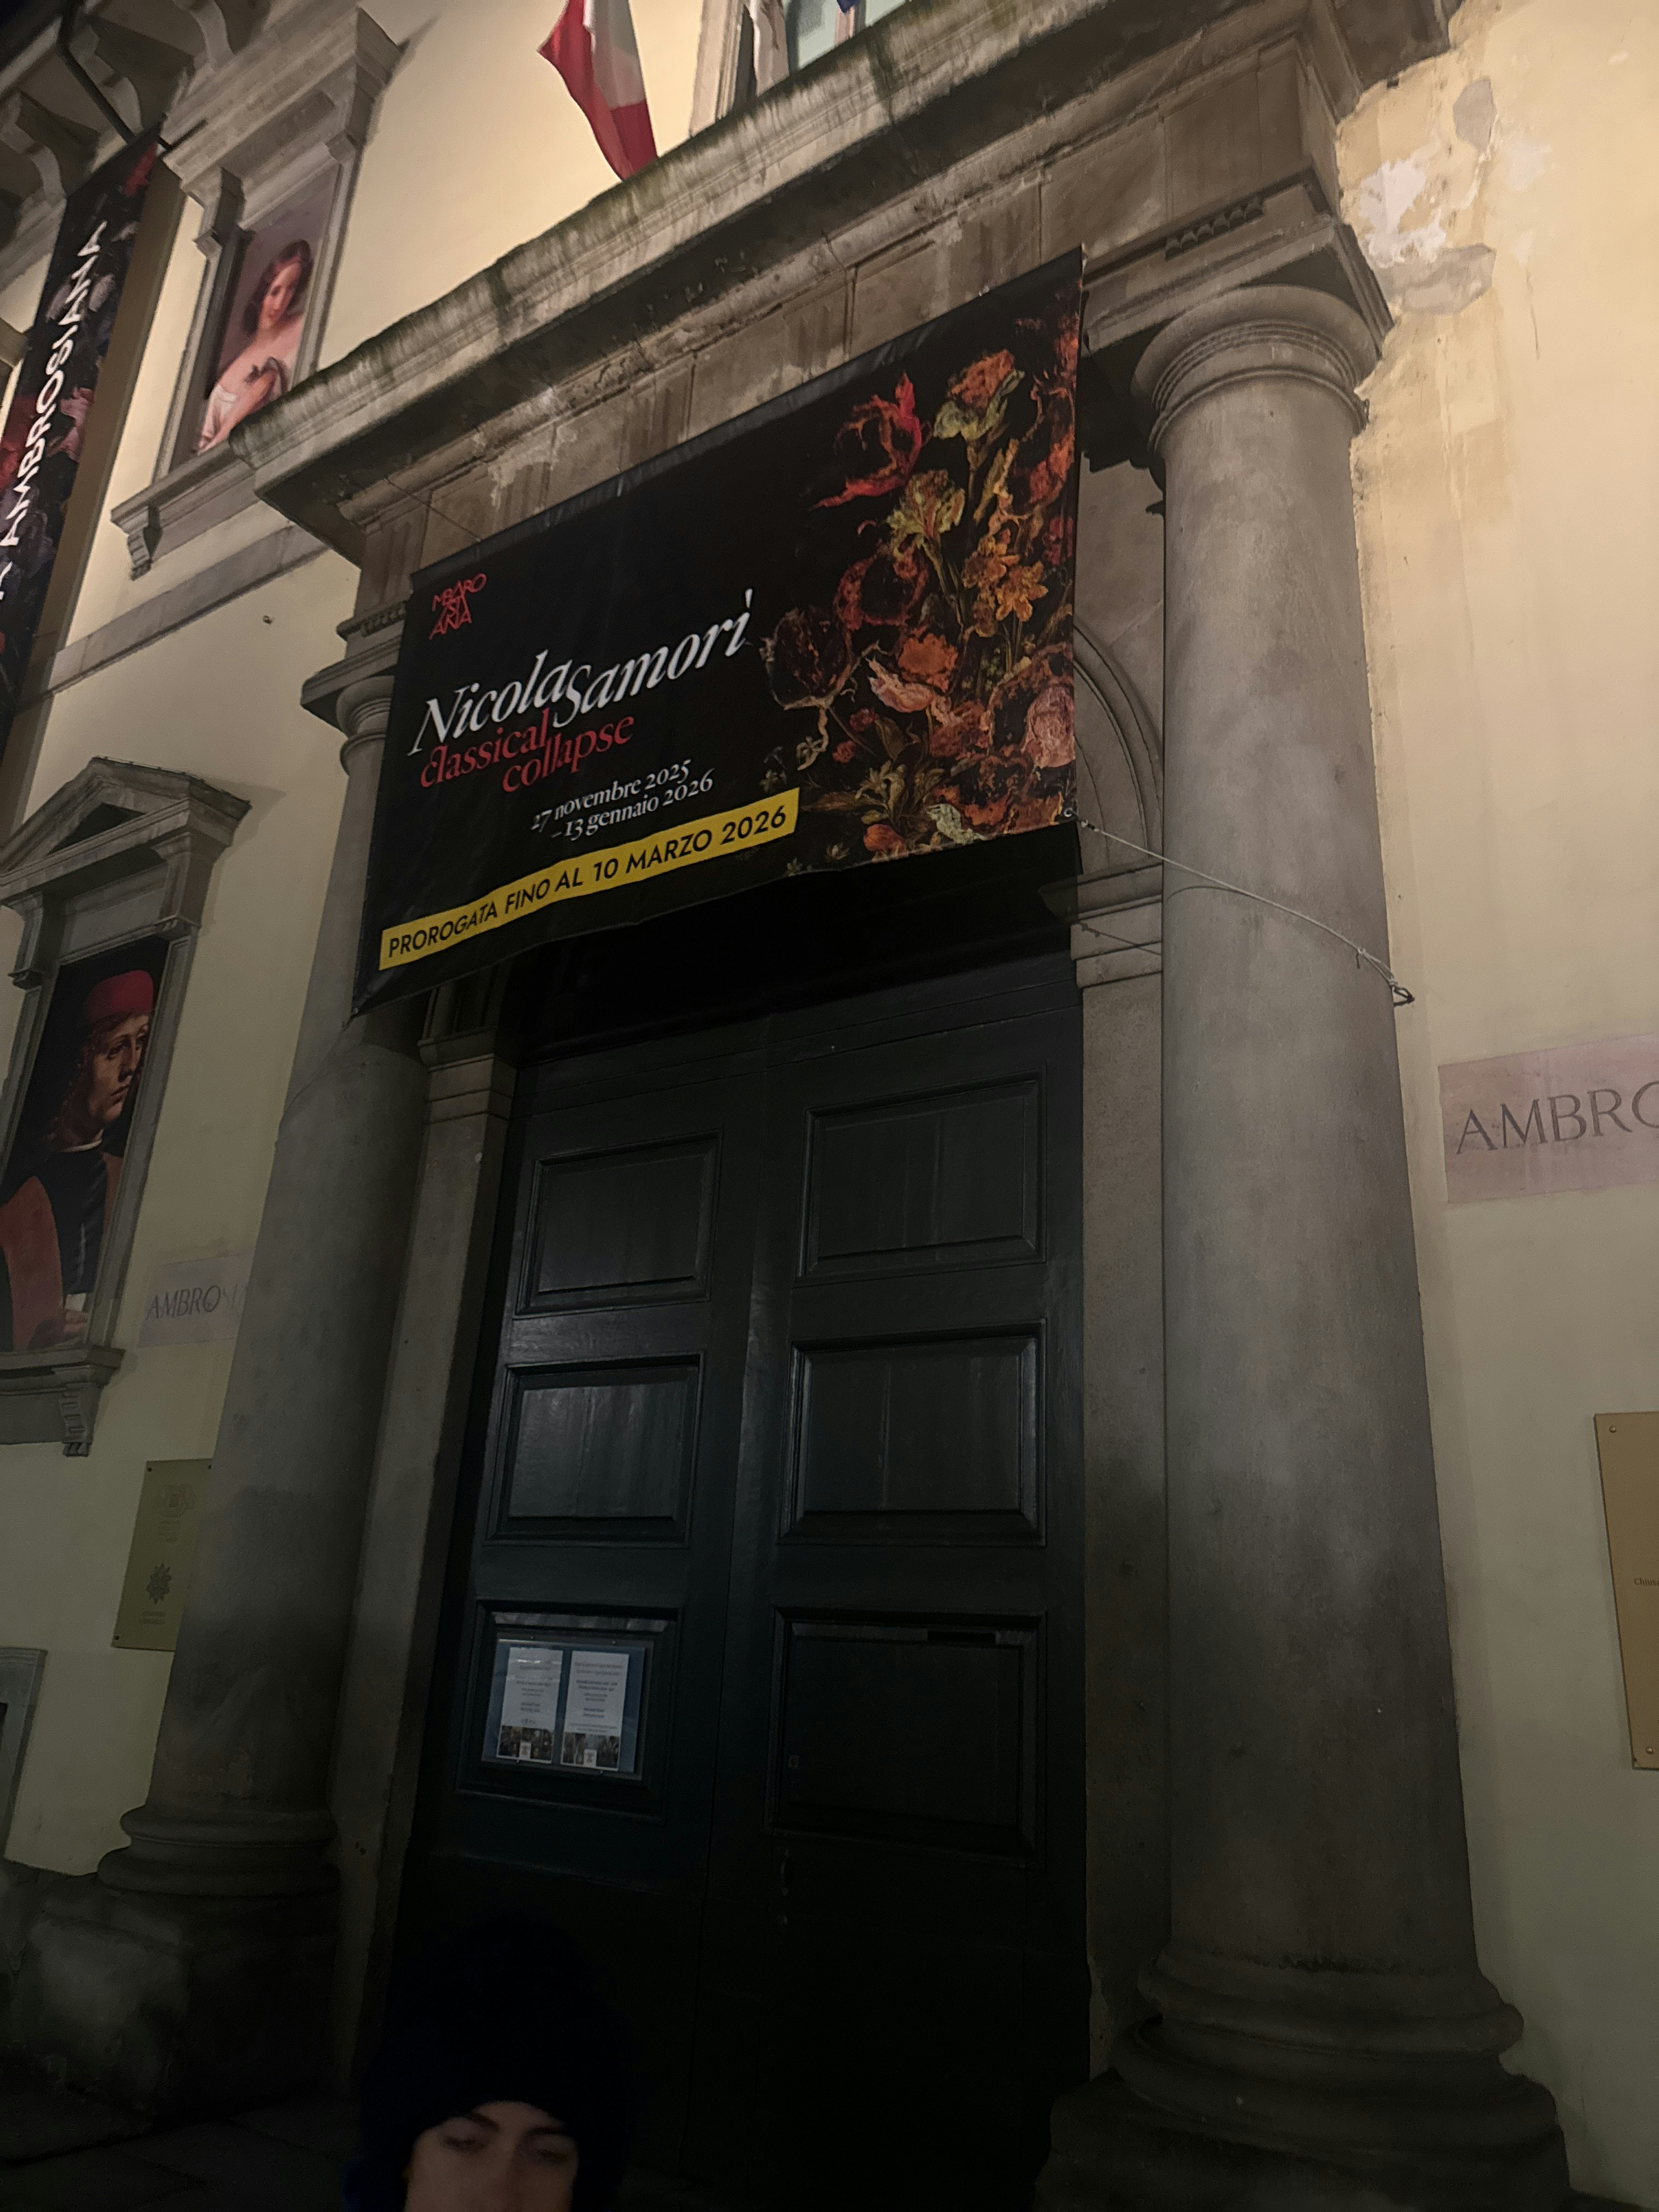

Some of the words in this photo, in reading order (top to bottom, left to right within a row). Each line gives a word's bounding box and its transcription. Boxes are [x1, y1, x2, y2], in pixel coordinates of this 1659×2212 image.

[1, 221, 107, 546] AMBROSIANA
[407, 650, 573, 756] Nicola
[420, 708, 549, 788] classical
[502, 716, 635, 793] collapse
[531, 810, 553, 832] 27
[555, 778, 641, 820] novembre
[645, 759, 691, 790] 2025
[586, 794, 659, 836] gennaio
[663, 768, 714, 806] 2026
[388, 902, 498, 958] PROROGATA
[504, 879, 550, 915] FINO
[555, 867, 583, 892] AL
[594, 858, 619, 882] 10
[626, 830, 713, 873] MARZO
[720, 805, 787, 845] 2026
